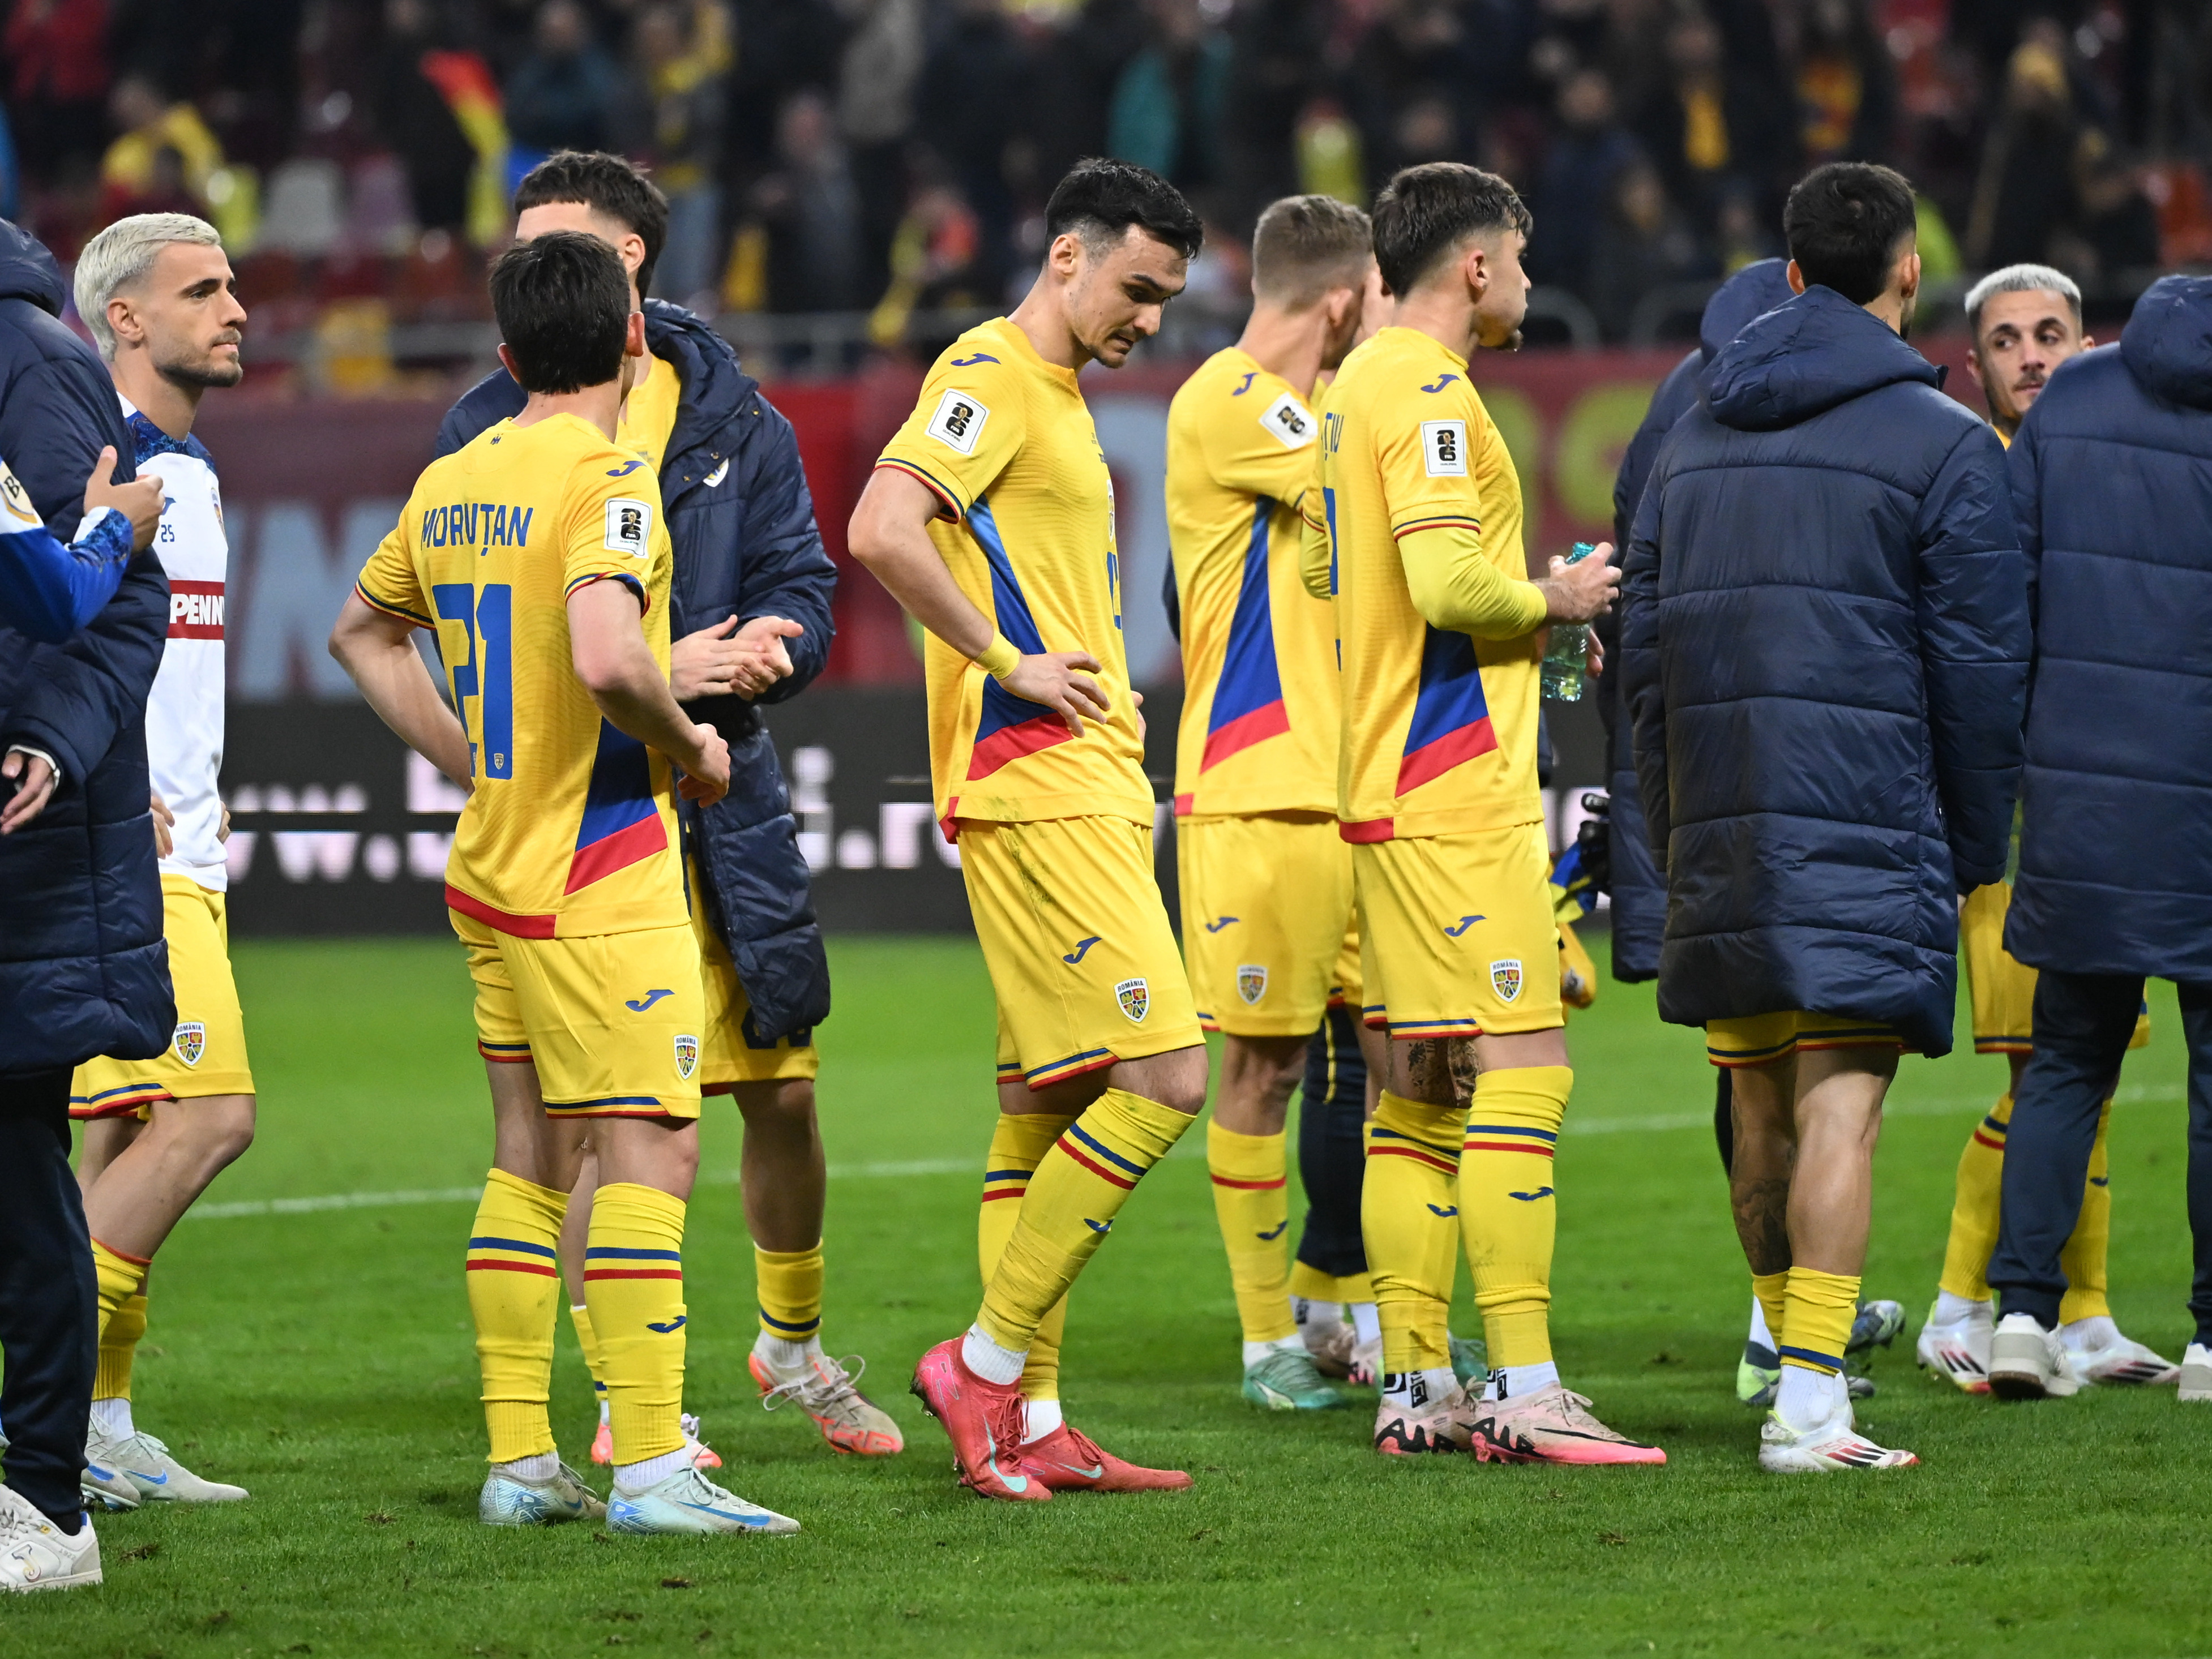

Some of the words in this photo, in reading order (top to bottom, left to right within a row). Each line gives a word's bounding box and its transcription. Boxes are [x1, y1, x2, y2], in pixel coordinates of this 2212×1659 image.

[161, 524, 175, 542] 25
[170, 593, 225, 625] PENN
[432, 584, 512, 780] 21
[1492, 961, 1518, 970] ROMÂNIA
[1118, 980, 1144, 992] ROMÂNIA
[676, 1036, 696, 1045] ROMÂNIA
